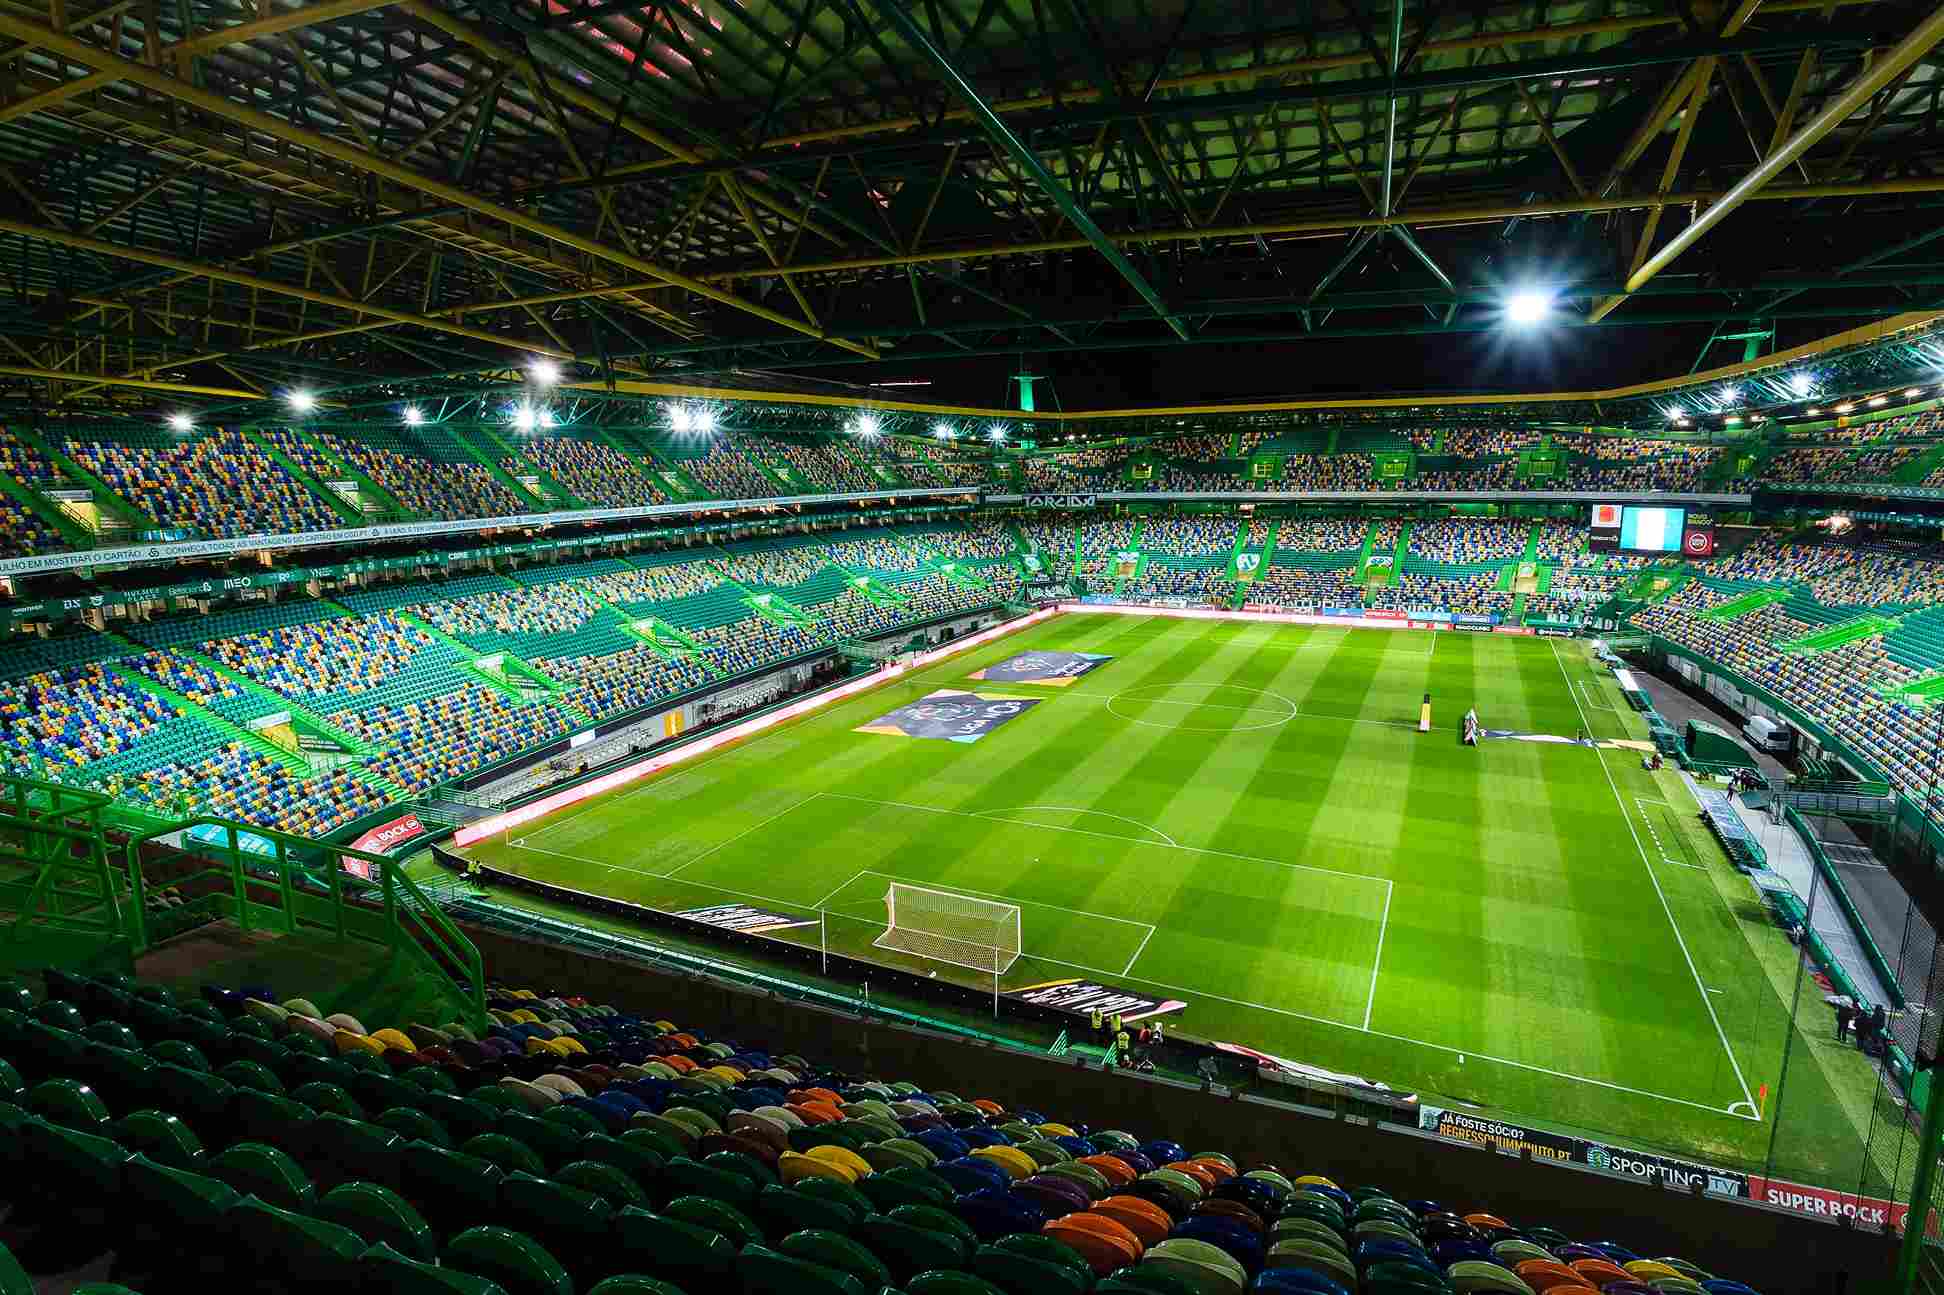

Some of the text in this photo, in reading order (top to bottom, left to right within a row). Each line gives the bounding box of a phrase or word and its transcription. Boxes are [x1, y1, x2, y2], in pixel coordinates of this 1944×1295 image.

[223, 576, 251, 590] MEO
[377, 824, 410, 842] BOCK
[1441, 1112, 1525, 1139] JÁ FOSTE SÓCIO?
[1612, 1156, 1740, 1197] SPORTING TV
[1767, 1188, 1885, 1225] SUPER BOCK
